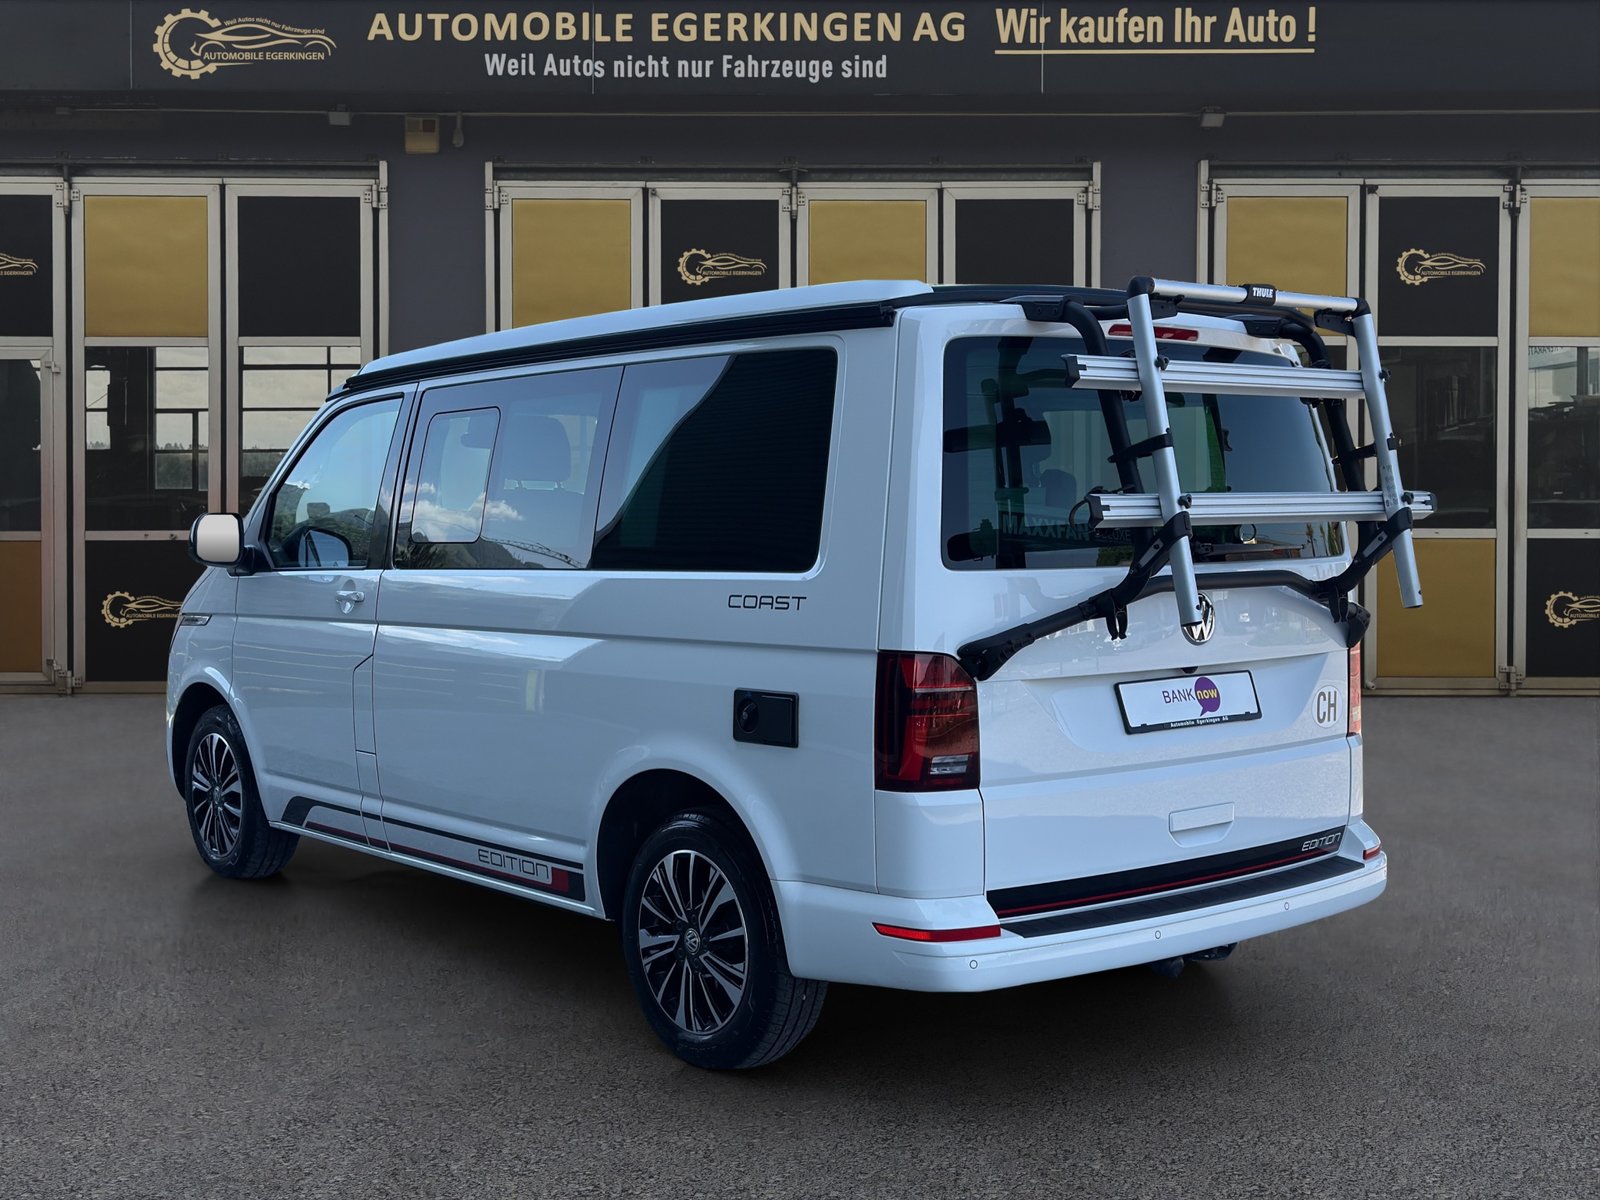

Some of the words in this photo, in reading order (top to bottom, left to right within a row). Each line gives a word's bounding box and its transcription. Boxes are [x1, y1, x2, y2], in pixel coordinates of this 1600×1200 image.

[224, 18, 237, 26] Weil
[238, 16, 255, 24] Autos
[256, 17, 271, 25] nicht
[271, 21, 281, 29] nur
[281, 24, 311, 34] Fahrzeuge
[367, 11, 633, 42] AUTOMOBILE
[650, 11, 902, 42] EGERKINGEN
[912, 11, 965, 42] AG
[995, 7, 1051, 44] Wir
[1060, 7, 1164, 44] kaufen
[1174, 7, 1217, 43] Ihr
[1224, 7, 1297, 43] Auto
[1307, 6, 1317, 42] !
[203, 52, 264, 61] AUTOMOBILE
[266, 52, 325, 61] EGERKINGEN
[484, 53, 536, 76] Weil
[543, 53, 605, 78] Autos
[613, 55, 669, 78] nicht
[677, 58, 714, 78] nur
[722, 54, 833, 83] Fahrzeuge
[841, 54, 888, 78] sind
[1252, 287, 1273, 298] THULE
[1002, 512, 1090, 541] MAXXFAN
[728, 594, 807, 611] COAST
[1162, 688, 1196, 704] BANK
[1196, 688, 1218, 700] now
[1316, 690, 1337, 724] CH
[1170, 720, 1195, 728] Automobile
[1196, 717, 1220, 726] Egerkingen
[1301, 832, 1341, 852] EDITION
[478, 848, 549, 880] EDITION
